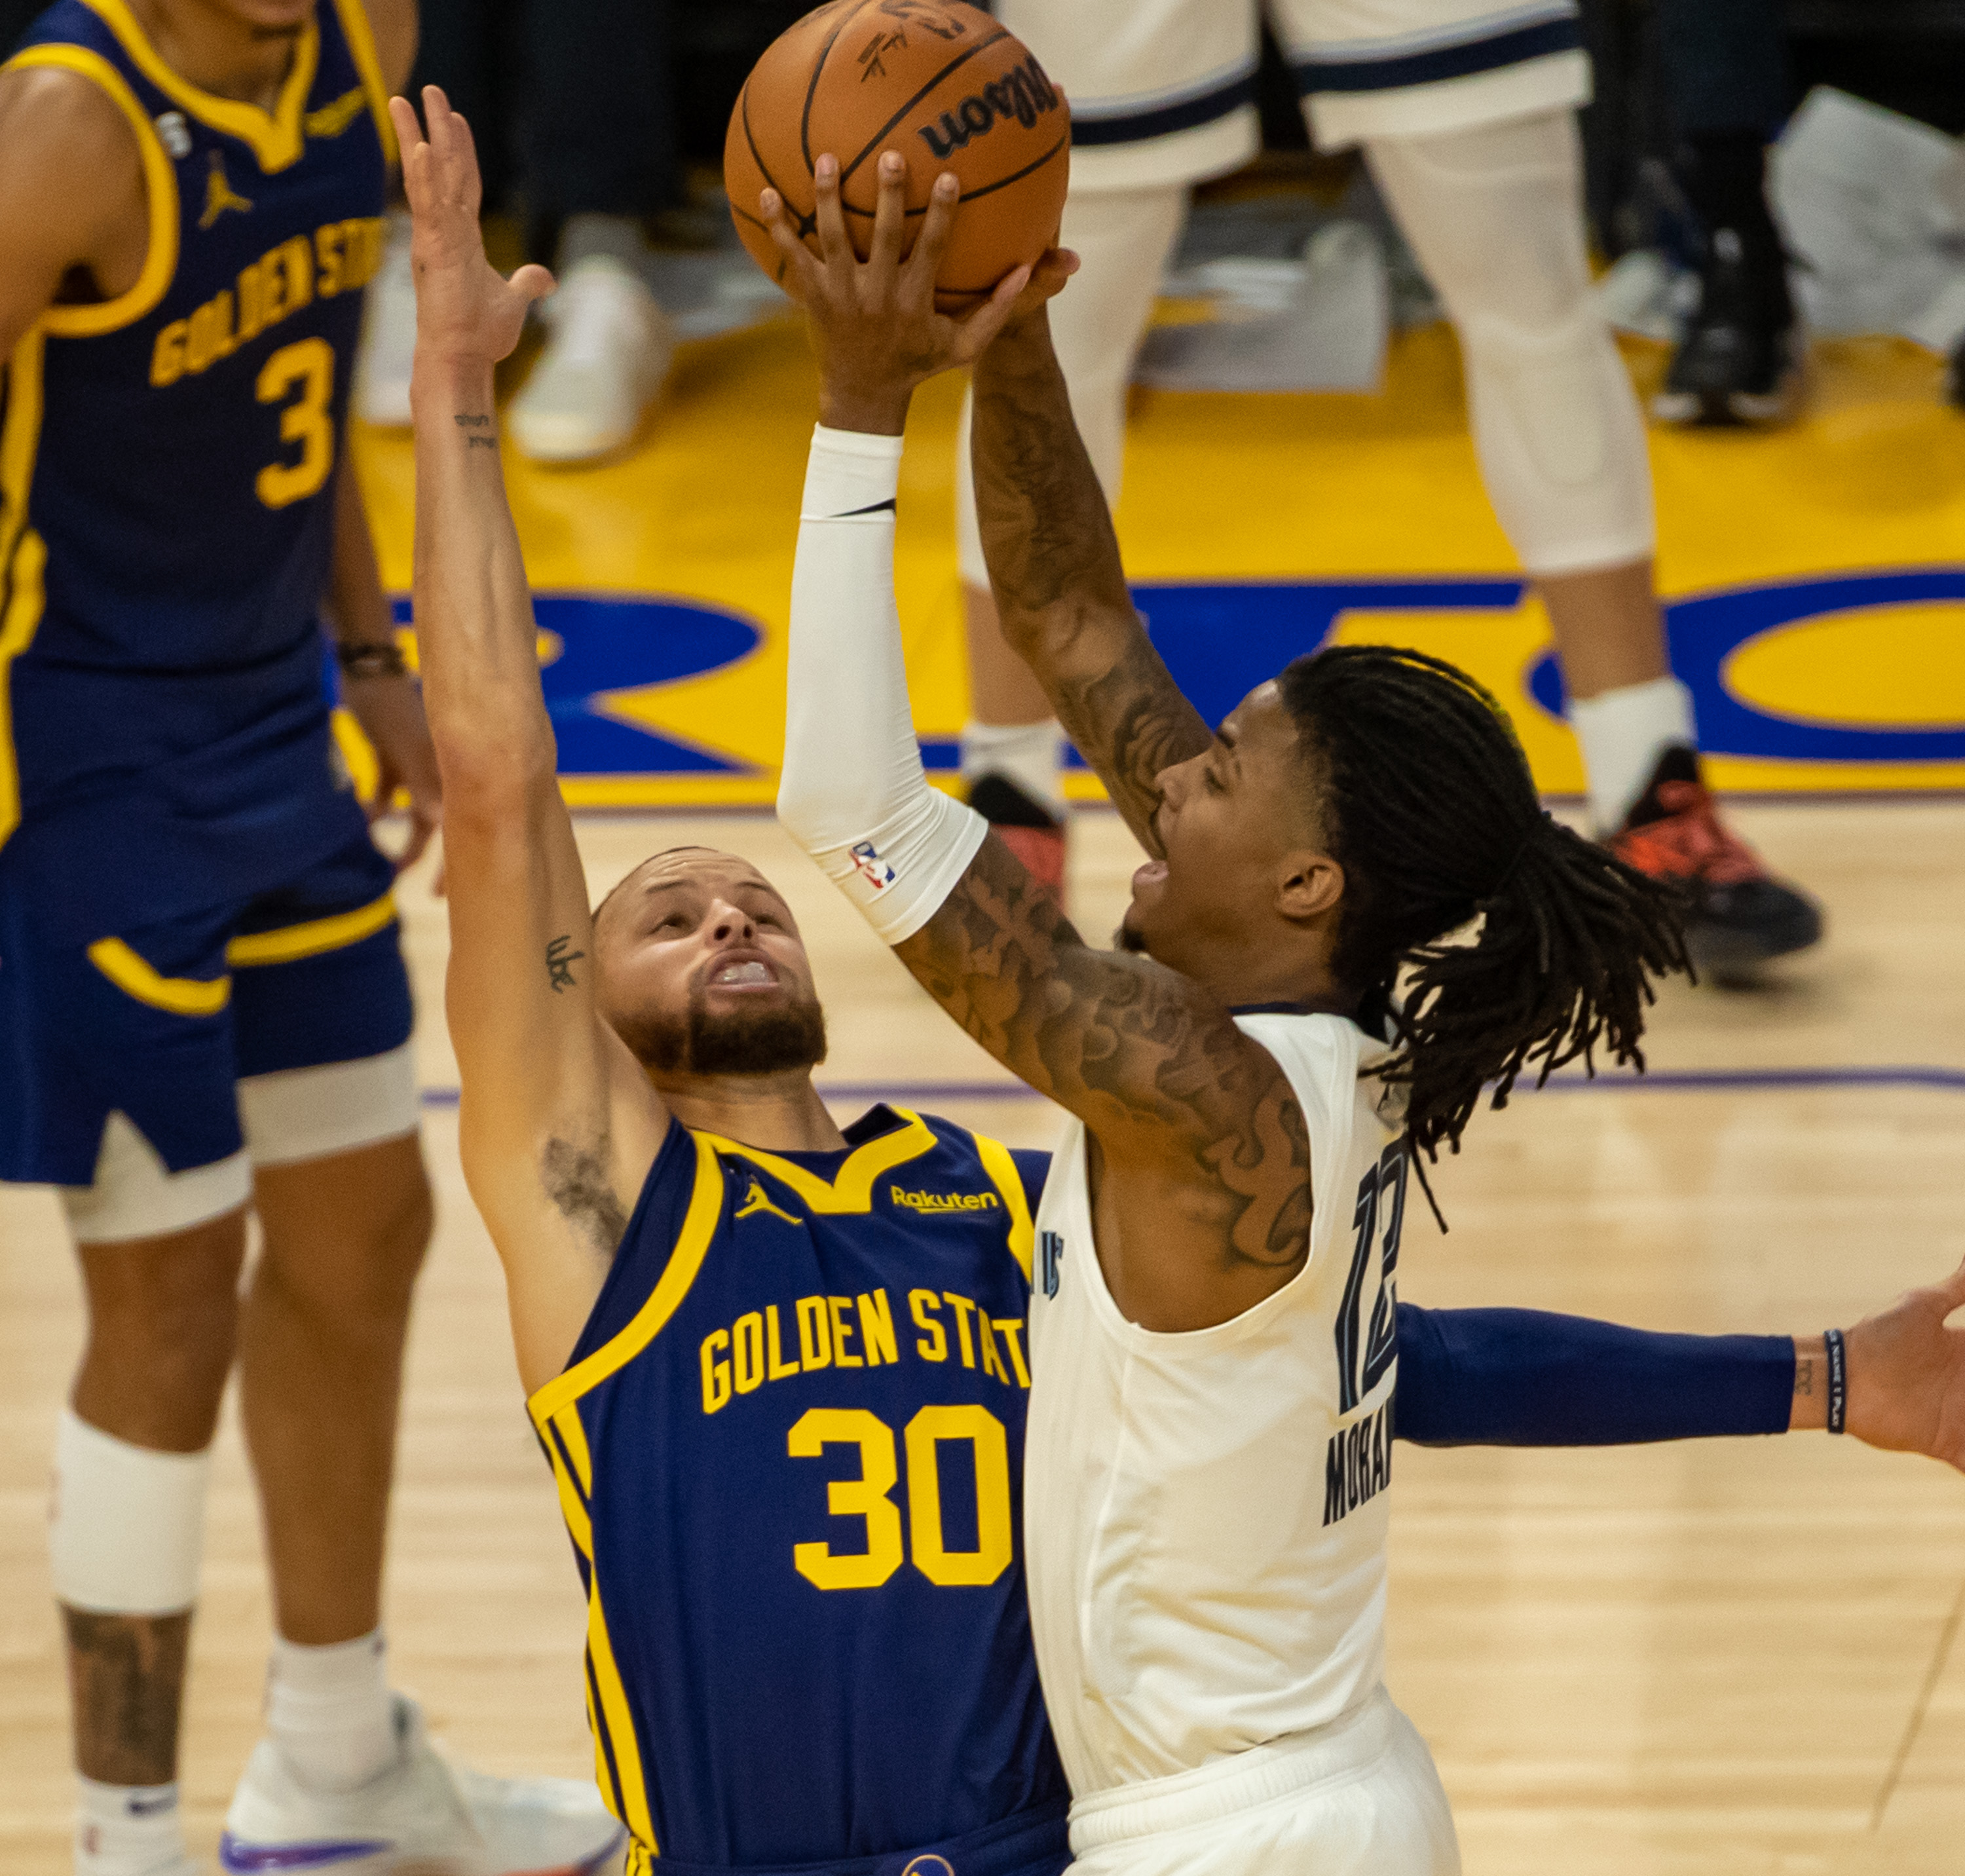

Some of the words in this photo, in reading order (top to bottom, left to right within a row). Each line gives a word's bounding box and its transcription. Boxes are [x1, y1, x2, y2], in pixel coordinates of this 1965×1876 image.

[255, 336, 335, 510] 3
[890, 1185, 1000, 1211] Rakuten
[1334, 1132, 1410, 1416] 12
[700, 1288, 898, 1414] GOLDEN
[908, 1288, 1032, 1389] STAT
[787, 1404, 1013, 1590] 30
[1322, 1393, 1395, 1528] MORA
